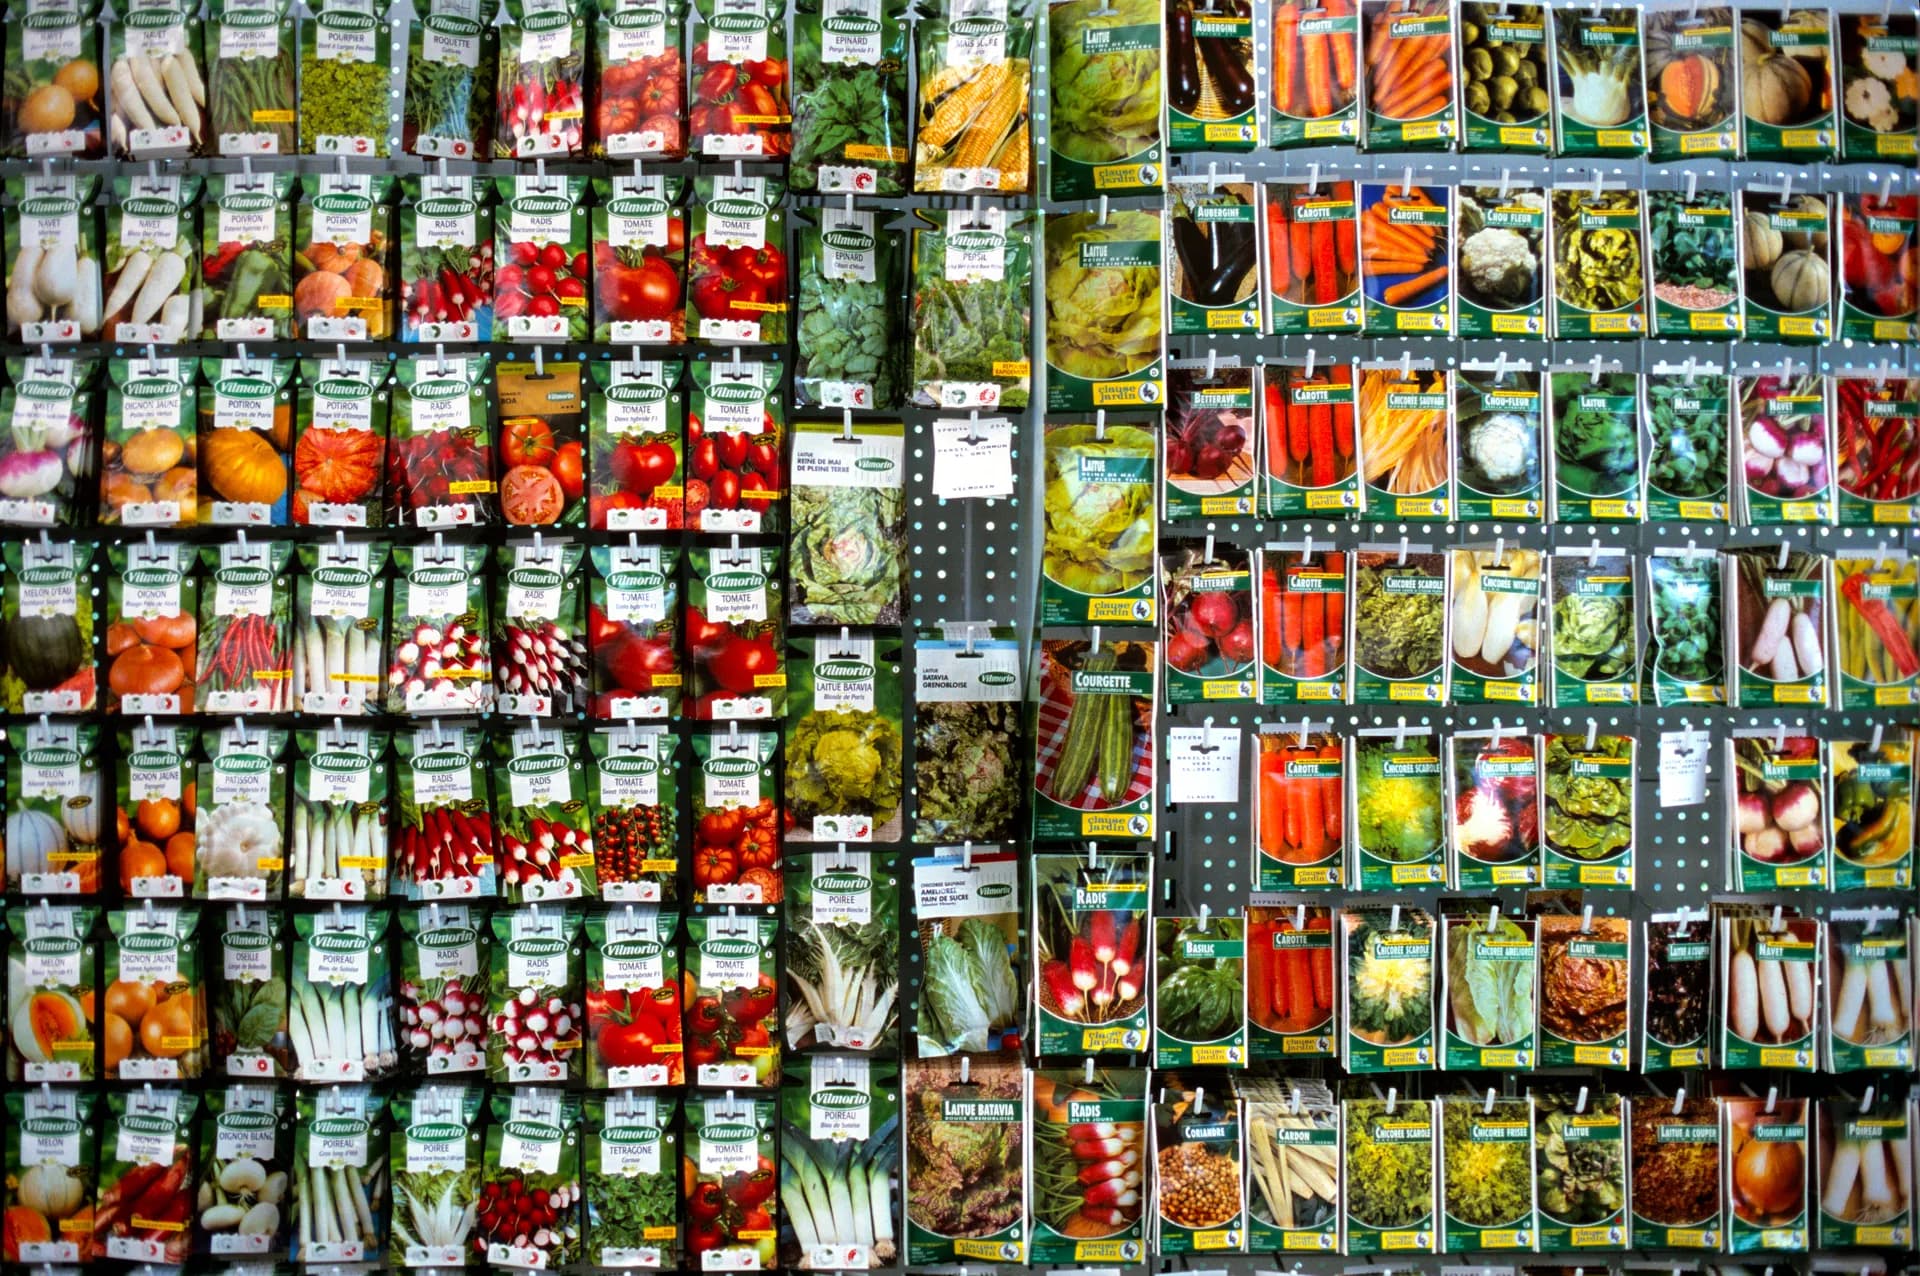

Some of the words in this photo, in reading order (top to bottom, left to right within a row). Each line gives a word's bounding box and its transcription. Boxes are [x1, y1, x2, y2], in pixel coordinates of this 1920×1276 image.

[26, 13, 77, 27] Vilmorin
[322, 14, 373, 27] Vilmorin
[524, 14, 567, 29] Vilmorin
[826, 19, 878, 32] Vilmorin
[1300, 20, 1332, 32] CAROTTE
[1195, 21, 1237, 33] AUBERGINE
[1392, 23, 1425, 34] CAROTTE
[433, 36, 470, 48] ROQUETTE
[623, 32, 651, 42] TOMATE
[724, 35, 753, 45] TOMATE
[835, 37, 868, 45] EPINARD
[1675, 33, 1702, 46] MELON
[1771, 31, 1799, 44] MELON
[225, 196, 275, 210] Vilmorin
[421, 201, 472, 215] Vilmorin
[712, 202, 763, 217] Vilmorin
[1197, 207, 1240, 219] AUBERGINE
[1297, 206, 1330, 218] CAROTTE
[1391, 208, 1423, 220] CAROTTE
[231, 214, 263, 224] POIVRON
[325, 216, 358, 225] POTIRON
[530, 217, 552, 226] RADIS
[1487, 210, 1508, 222] CHOU
[1510, 211, 1532, 223] FLEUR
[1581, 214, 1607, 225] LAITUE
[1771, 215, 1798, 227] MELON
[38, 219, 61, 228] NAVET
[138, 220, 161, 229] NAVET
[435, 220, 457, 229] RADIS
[623, 220, 653, 229] TOMATE
[721, 221, 750, 231] TOMATE
[835, 252, 863, 262] EPINARD
[128, 381, 178, 395] Vilmorin
[317, 381, 369, 394] Vilmorin
[710, 386, 762, 399] Vilmorin
[1194, 393, 1235, 405] BETTERAVE
[1295, 389, 1328, 401] CAROTTE
[1485, 395, 1529, 407] CHOU-FLEUR
[228, 401, 261, 410] POTIRON
[326, 401, 358, 410] POTIRON
[430, 401, 452, 411] RADIS
[622, 405, 651, 414] TOMATE
[1581, 398, 1606, 409] LAITUE
[1769, 399, 1793, 411] NAVET
[1867, 401, 1896, 412] PIMENT
[720, 406, 749, 415] TOMATE
[220, 569, 269, 582] Vilmorin
[414, 570, 464, 583] Vilmorin
[711, 573, 762, 587] Vilmorin
[1193, 576, 1235, 589] BETTERAVE
[1290, 576, 1323, 588] CAROTTE
[1579, 580, 1604, 592] LAITUE
[137, 590, 166, 600] OIGNON
[524, 591, 545, 600] RADIS
[722, 594, 752, 604] TOMATE
[923, 674, 948, 682] BATAVIA
[980, 674, 1015, 684] Vilmorin
[1075, 673, 1130, 690] COURGETTE
[817, 682, 842, 691] LAITUE
[844, 682, 873, 692] BATAVIA
[923, 681, 967, 689] GRENOBLOISE
[218, 757, 269, 770] Vilmorin
[513, 756, 566, 772] Vilmorin
[708, 759, 757, 774] Vilmorin
[1287, 761, 1319, 774] CAROTTE
[1574, 761, 1600, 774] LAITUE
[38, 770, 65, 778] MELON
[324, 774, 356, 784] POIREAU
[431, 774, 453, 784] RADIS
[529, 777, 552, 787] RADIS
[615, 778, 643, 788] TOMATE
[718, 779, 746, 789] TOMATE
[1088, 816, 1125, 825] clause
[1089, 822, 1125, 833] jardin
[1076, 889, 1107, 905] RADIS
[315, 936, 367, 950] Vilmorin
[1276, 932, 1308, 945] CAROTTE
[30, 939, 79, 954] Vilmorin
[513, 940, 565, 954] Vilmorin
[1186, 940, 1215, 955] BASILIC
[1570, 942, 1596, 954] LAITUE
[1759, 944, 1783, 957] NAVET
[236, 953, 259, 962] OSEILLE
[322, 954, 355, 964] POIREAU
[437, 950, 459, 960] RADIS
[41, 958, 65, 967] MELON
[527, 959, 549, 969] RADIS
[618, 961, 648, 971] TOMATE
[715, 960, 745, 970] TOMATE
[815, 1093, 867, 1106] Vilmorin
[945, 1101, 976, 1116] LAITUE
[976, 1103, 1014, 1116] BATAVIA
[1071, 1103, 1100, 1118] RADIS
[825, 1111, 856, 1120] POIREAU
[26, 1119, 77, 1134] Vilmorin
[315, 1119, 366, 1133] Vilmorin
[509, 1122, 559, 1138] Vilmorin
[1563, 1124, 1590, 1138] LAITUE
[1848, 1124, 1882, 1137] POIREAU
[219, 1131, 249, 1142] OIGNON
[1185, 1126, 1225, 1139] CORIANDRE
[1278, 1128, 1310, 1141] CARDON
[37, 1138, 64, 1147] MELON
[322, 1138, 354, 1148] POIREAU
[520, 1143, 542, 1153] RADIS
[714, 1143, 744, 1153] TOMATE
[610, 1145, 652, 1155] TETRAGONE
